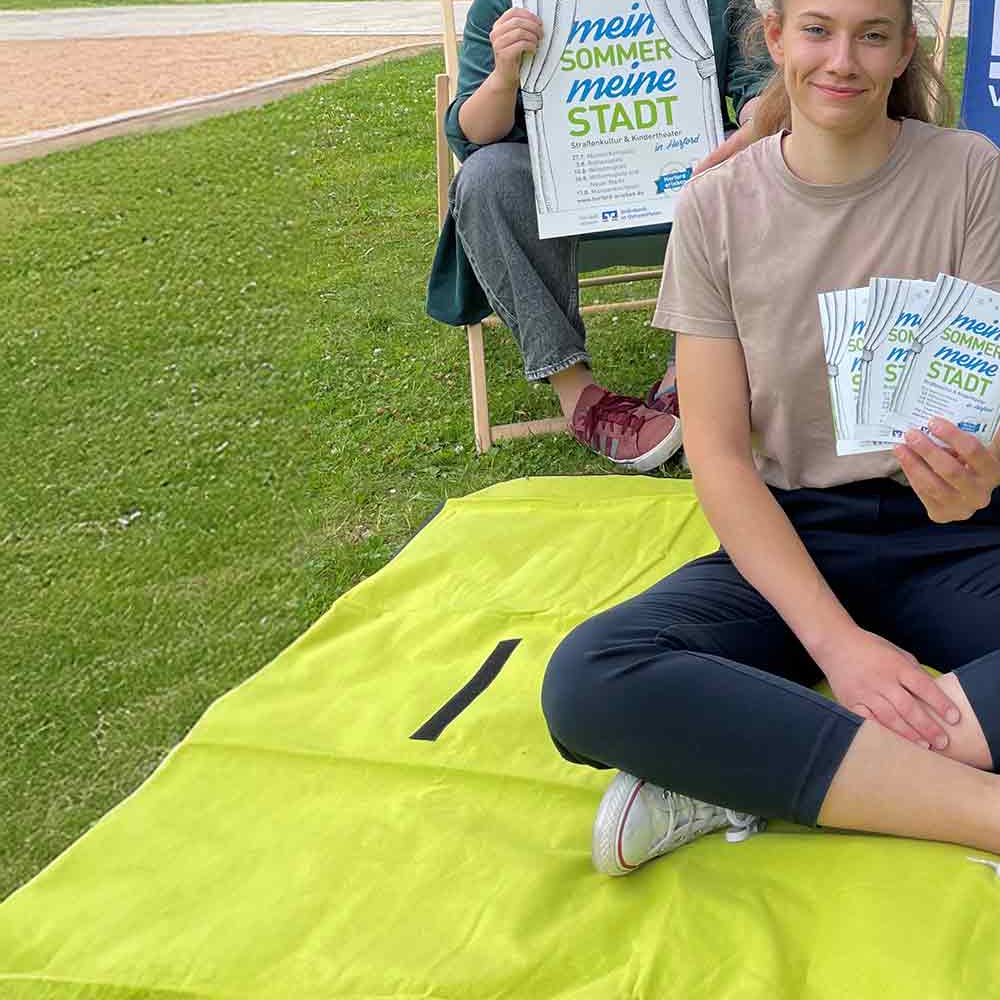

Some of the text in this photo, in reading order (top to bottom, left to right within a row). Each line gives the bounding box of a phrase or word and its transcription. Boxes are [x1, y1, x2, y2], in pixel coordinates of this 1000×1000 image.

[566, 2, 655, 44] mein
[560, 39, 673, 72] SOMMER
[566, 62, 676, 104] meine
[568, 96, 679, 137] STADT
[927, 359, 992, 397] STADT
[934, 345, 999, 377] meine
